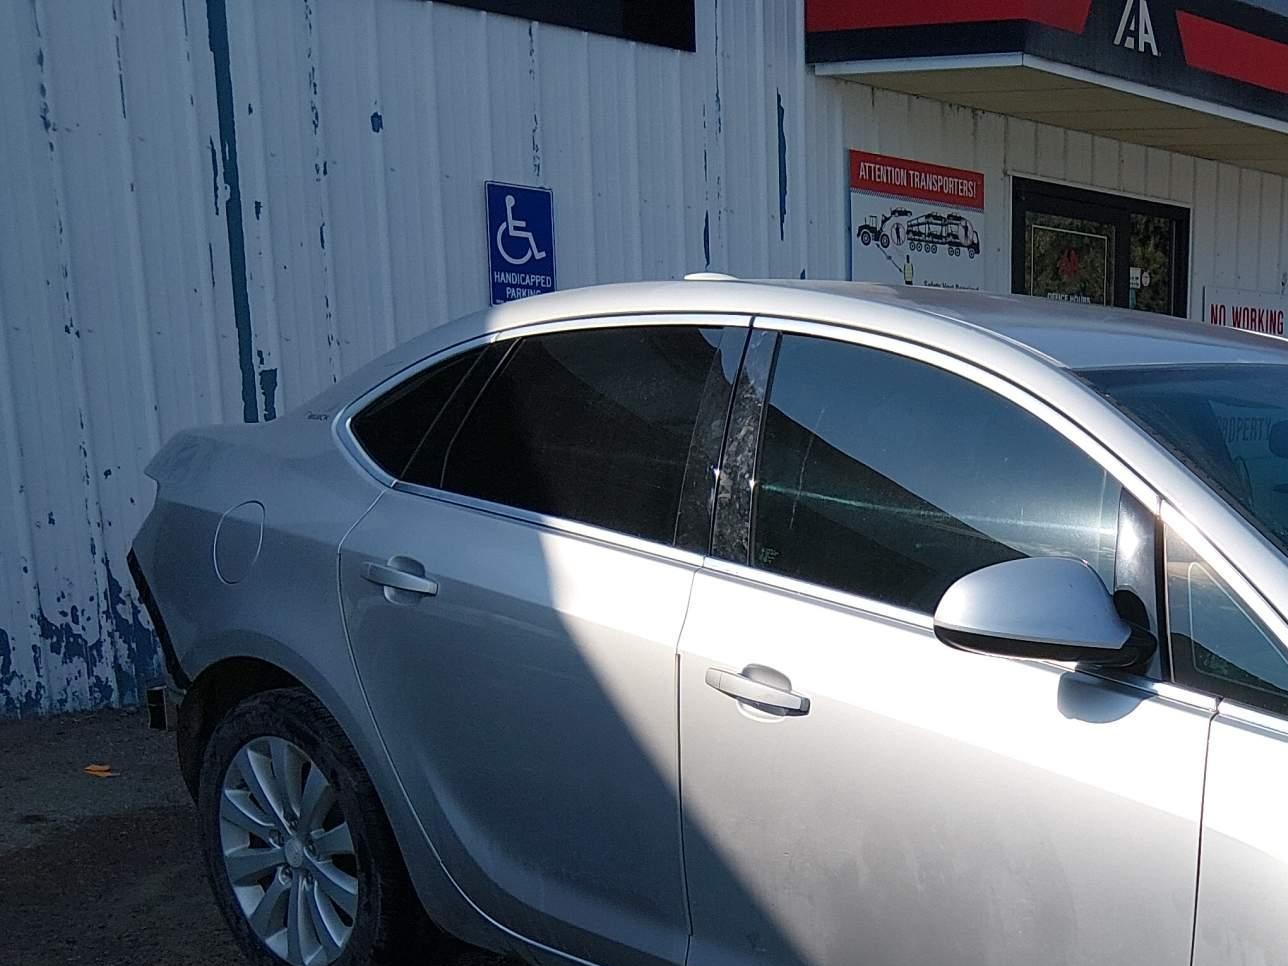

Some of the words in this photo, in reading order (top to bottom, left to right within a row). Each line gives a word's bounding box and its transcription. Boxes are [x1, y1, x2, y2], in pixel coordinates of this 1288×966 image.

[859, 162, 907, 187] ATTENTION
[909, 171, 977, 198] TRANSPORTERS!
[494, 271, 552, 287] HANDICAPPED
[1210, 304, 1226, 326] NO
[1232, 306, 1284, 336] WORKING
